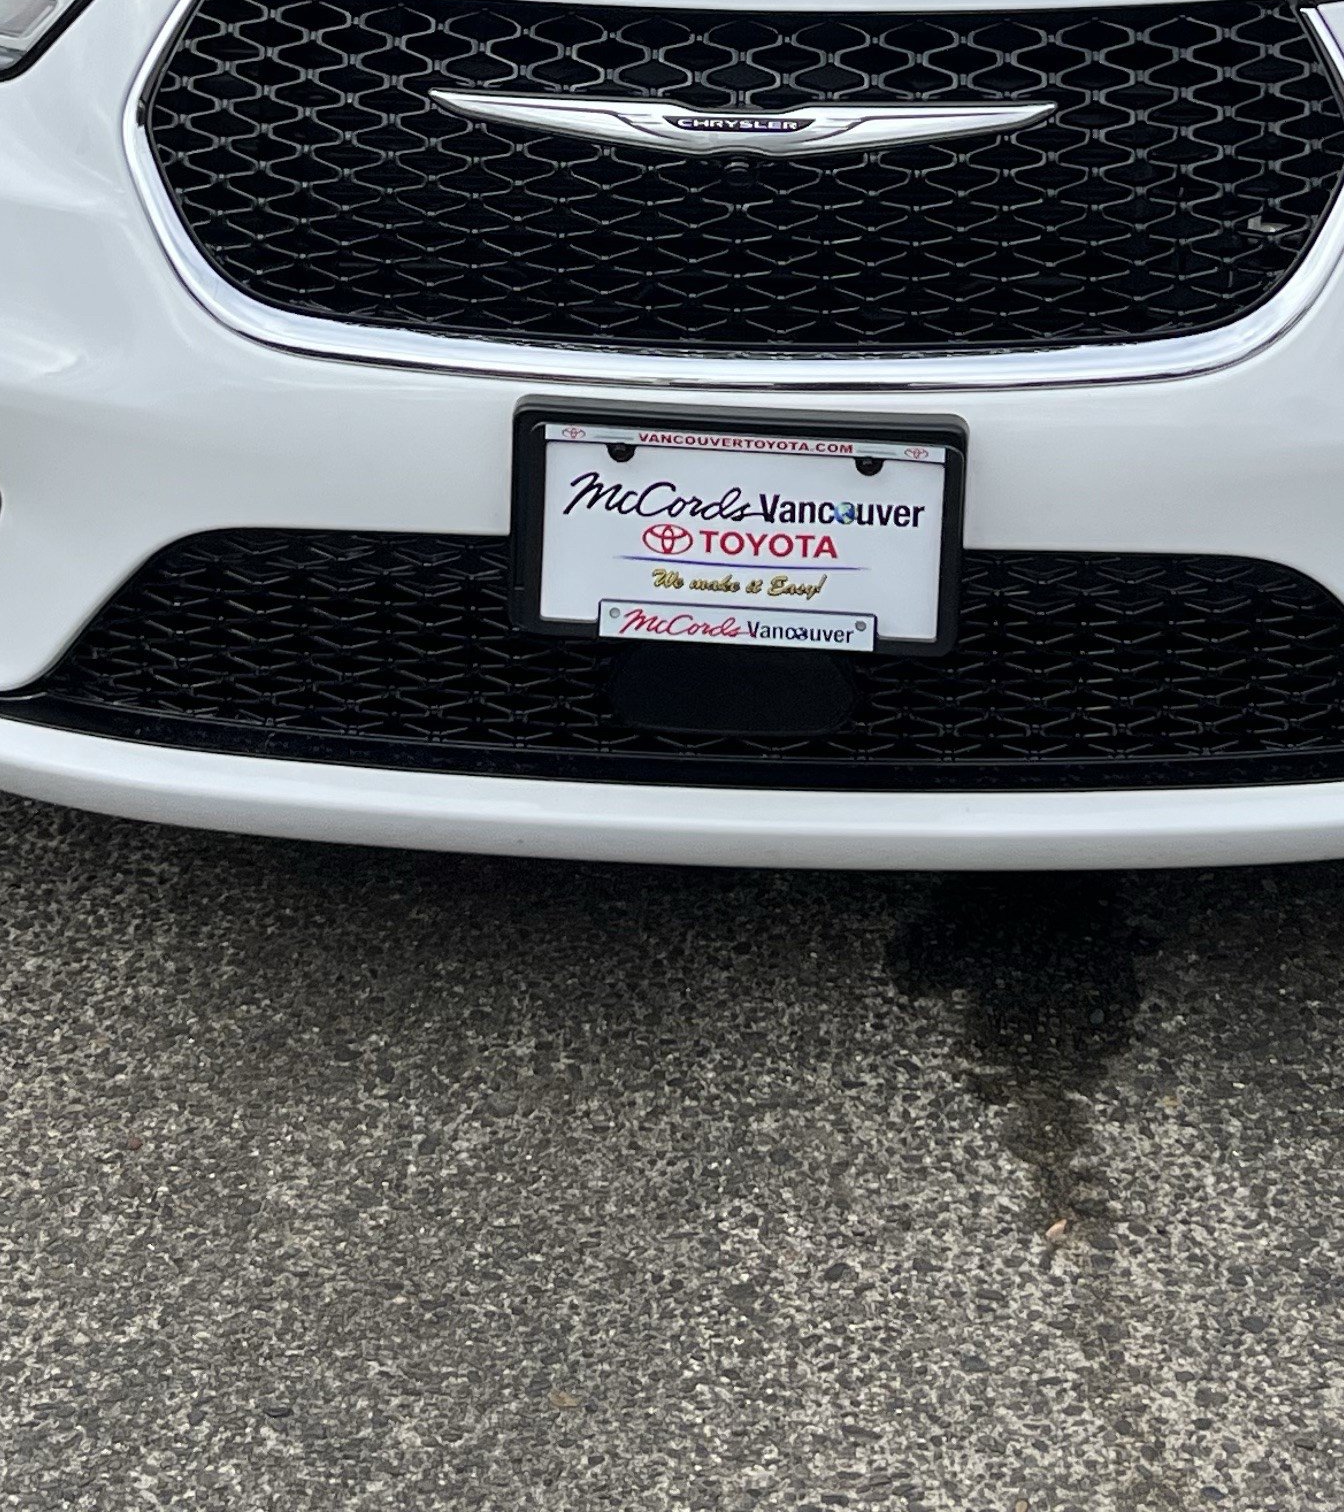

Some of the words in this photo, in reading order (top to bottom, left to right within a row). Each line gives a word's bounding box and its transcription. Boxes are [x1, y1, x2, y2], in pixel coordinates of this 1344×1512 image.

[677, 118, 798, 131] CHRYSLER
[638, 433, 853, 453] VANCOUVERTOYOTA.COM
[699, 529, 839, 559] TOYOTA
[652, 568, 684, 589] We
[689, 574, 740, 593] make
[745, 580, 762, 594] it
[767, 574, 827, 600] Easy!
